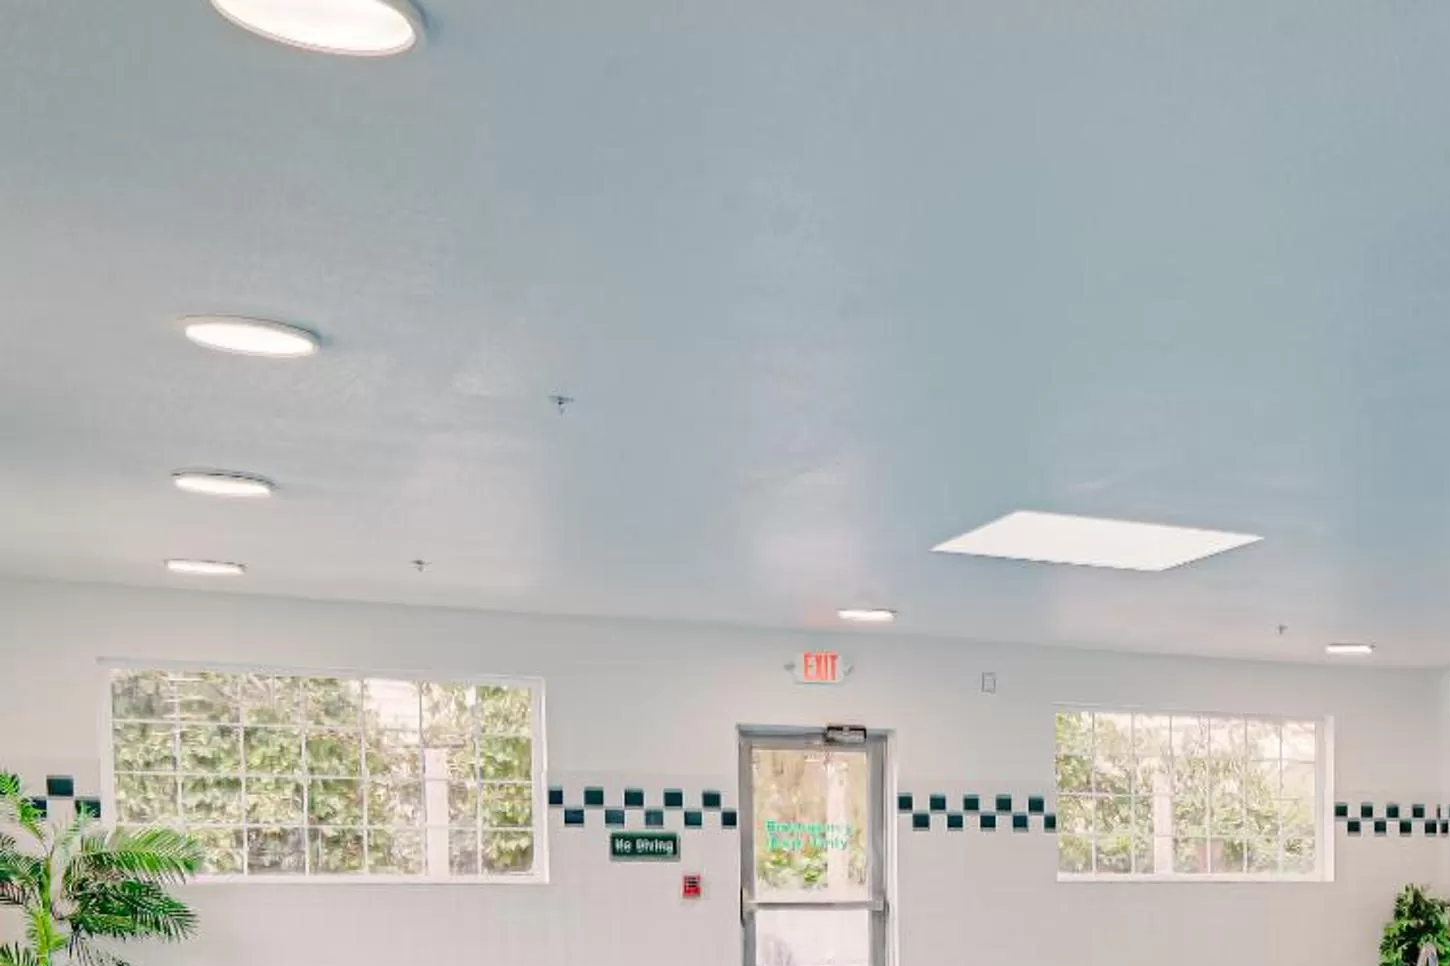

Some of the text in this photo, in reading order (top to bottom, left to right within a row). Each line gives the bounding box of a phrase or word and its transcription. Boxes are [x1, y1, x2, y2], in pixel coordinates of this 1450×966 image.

[803, 651, 838, 681] EXIT
[615, 838, 674, 856] No Diving
